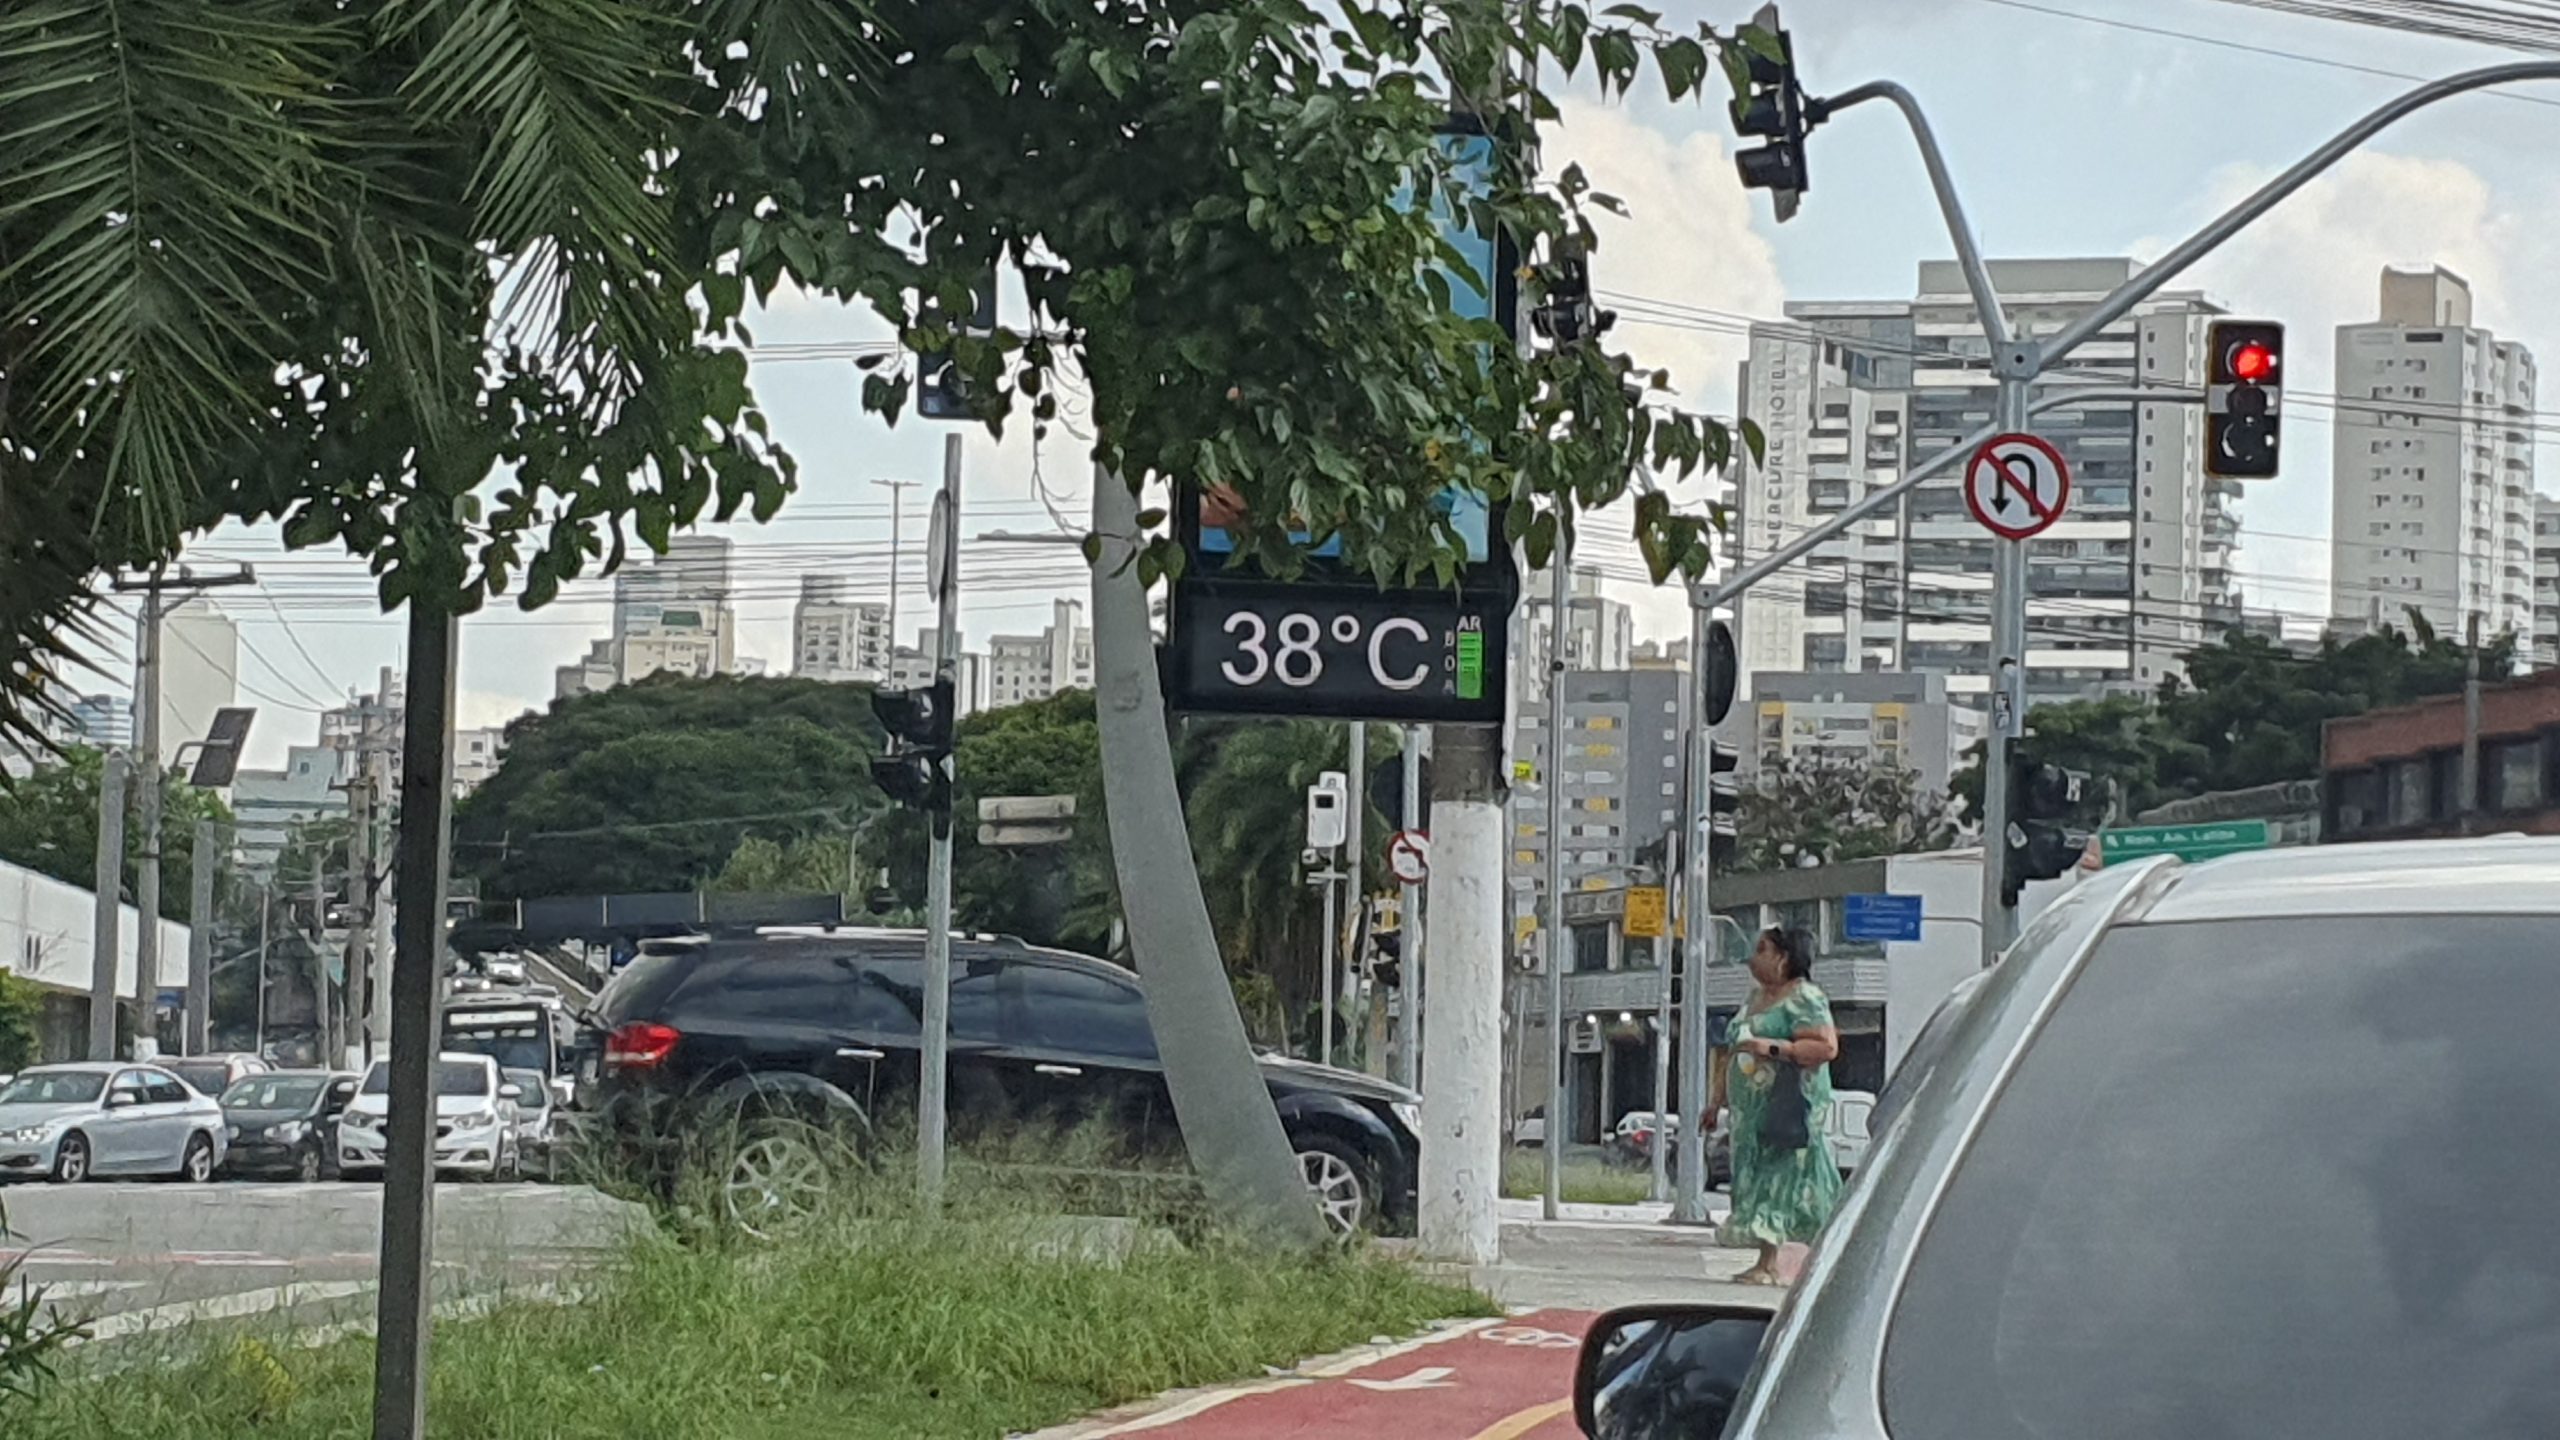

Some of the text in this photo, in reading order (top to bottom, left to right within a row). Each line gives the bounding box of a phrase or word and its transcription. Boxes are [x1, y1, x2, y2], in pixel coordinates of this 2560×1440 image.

[1767, 353, 1786, 554] MERCURE HOTEL
[1221, 611, 1430, 690] 38°C
[1457, 615, 1482, 631] AR
